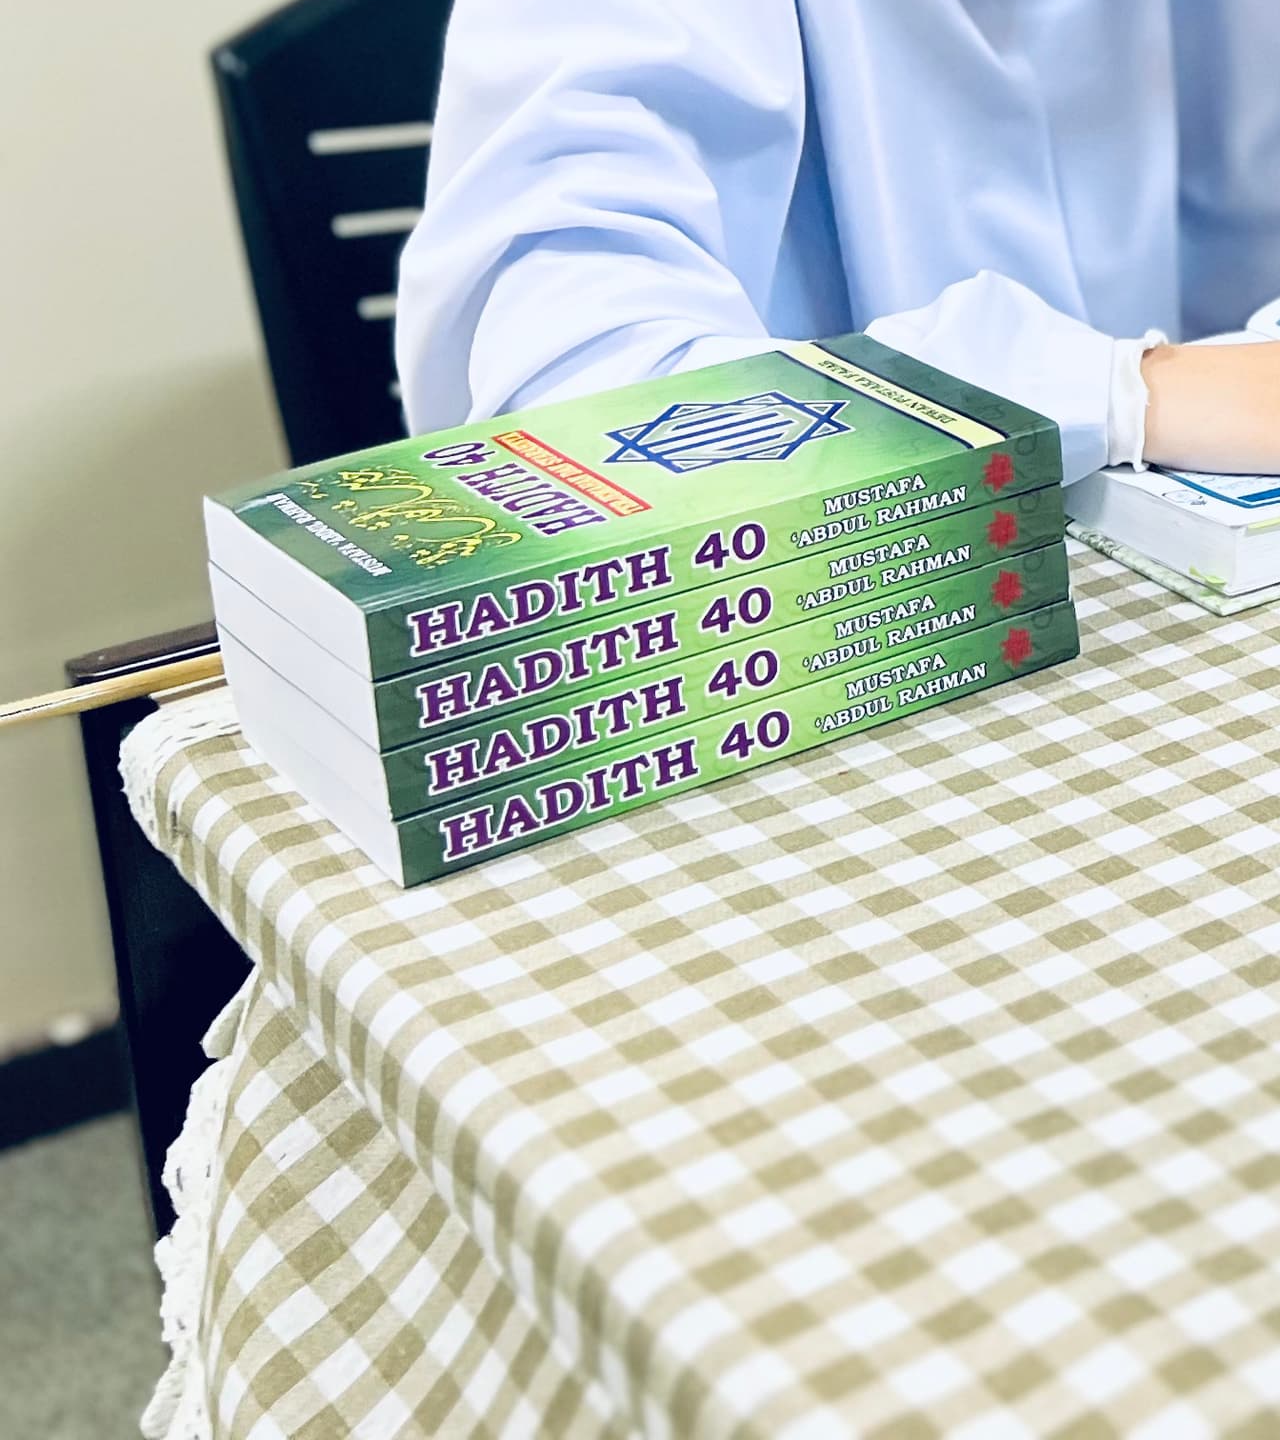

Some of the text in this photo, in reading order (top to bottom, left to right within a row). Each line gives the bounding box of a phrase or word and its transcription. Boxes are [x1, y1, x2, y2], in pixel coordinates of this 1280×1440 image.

[828, 231, 867, 276] NURUL
[907, 401, 957, 424] DEWAN
[266, 492, 316, 524] RAHMAN
[422, 441, 608, 535] HADITH 40
[824, 474, 926, 515] MUSTAFA
[877, 486, 967, 525] RAHMAN
[337, 542, 392, 576] MUSTAFA
[829, 534, 931, 577] MUSTAFA
[881, 544, 972, 585] RAHMAN
[410, 523, 766, 655] HADITH 40
[835, 595, 936, 639] MUSTAFA
[887, 604, 976, 647] RAHMAN
[419, 586, 772, 726] HADITH 40
[846, 653, 947, 699] MUSTAFA
[899, 662, 988, 706] RAHMAN
[429, 649, 779, 792] HADITH 40
[443, 710, 790, 858] HADITH 40
